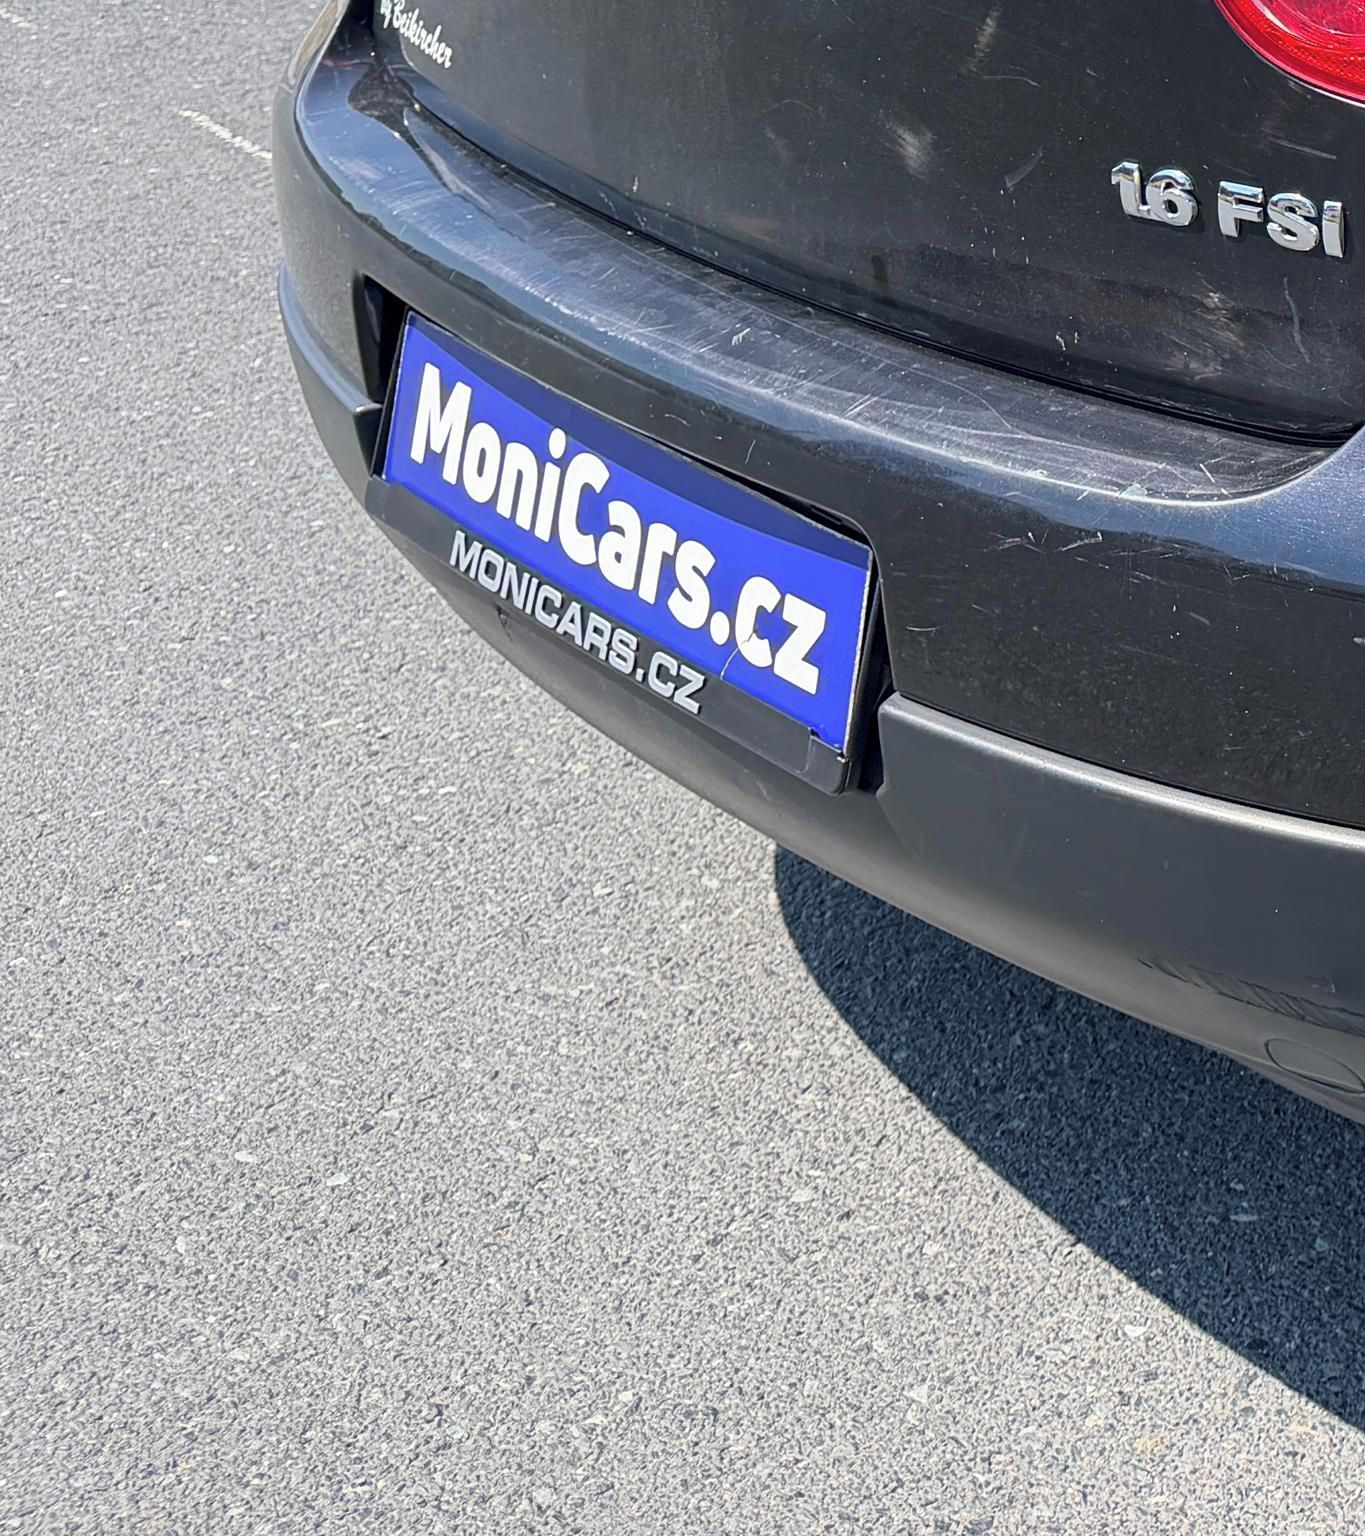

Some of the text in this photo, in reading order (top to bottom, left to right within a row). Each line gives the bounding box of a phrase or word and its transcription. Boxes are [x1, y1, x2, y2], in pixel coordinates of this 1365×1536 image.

[1216, 179, 1346, 259] FSI
[409, 361, 827, 695] MoniCars.cz
[449, 529, 706, 715] MONICARS.CZ
